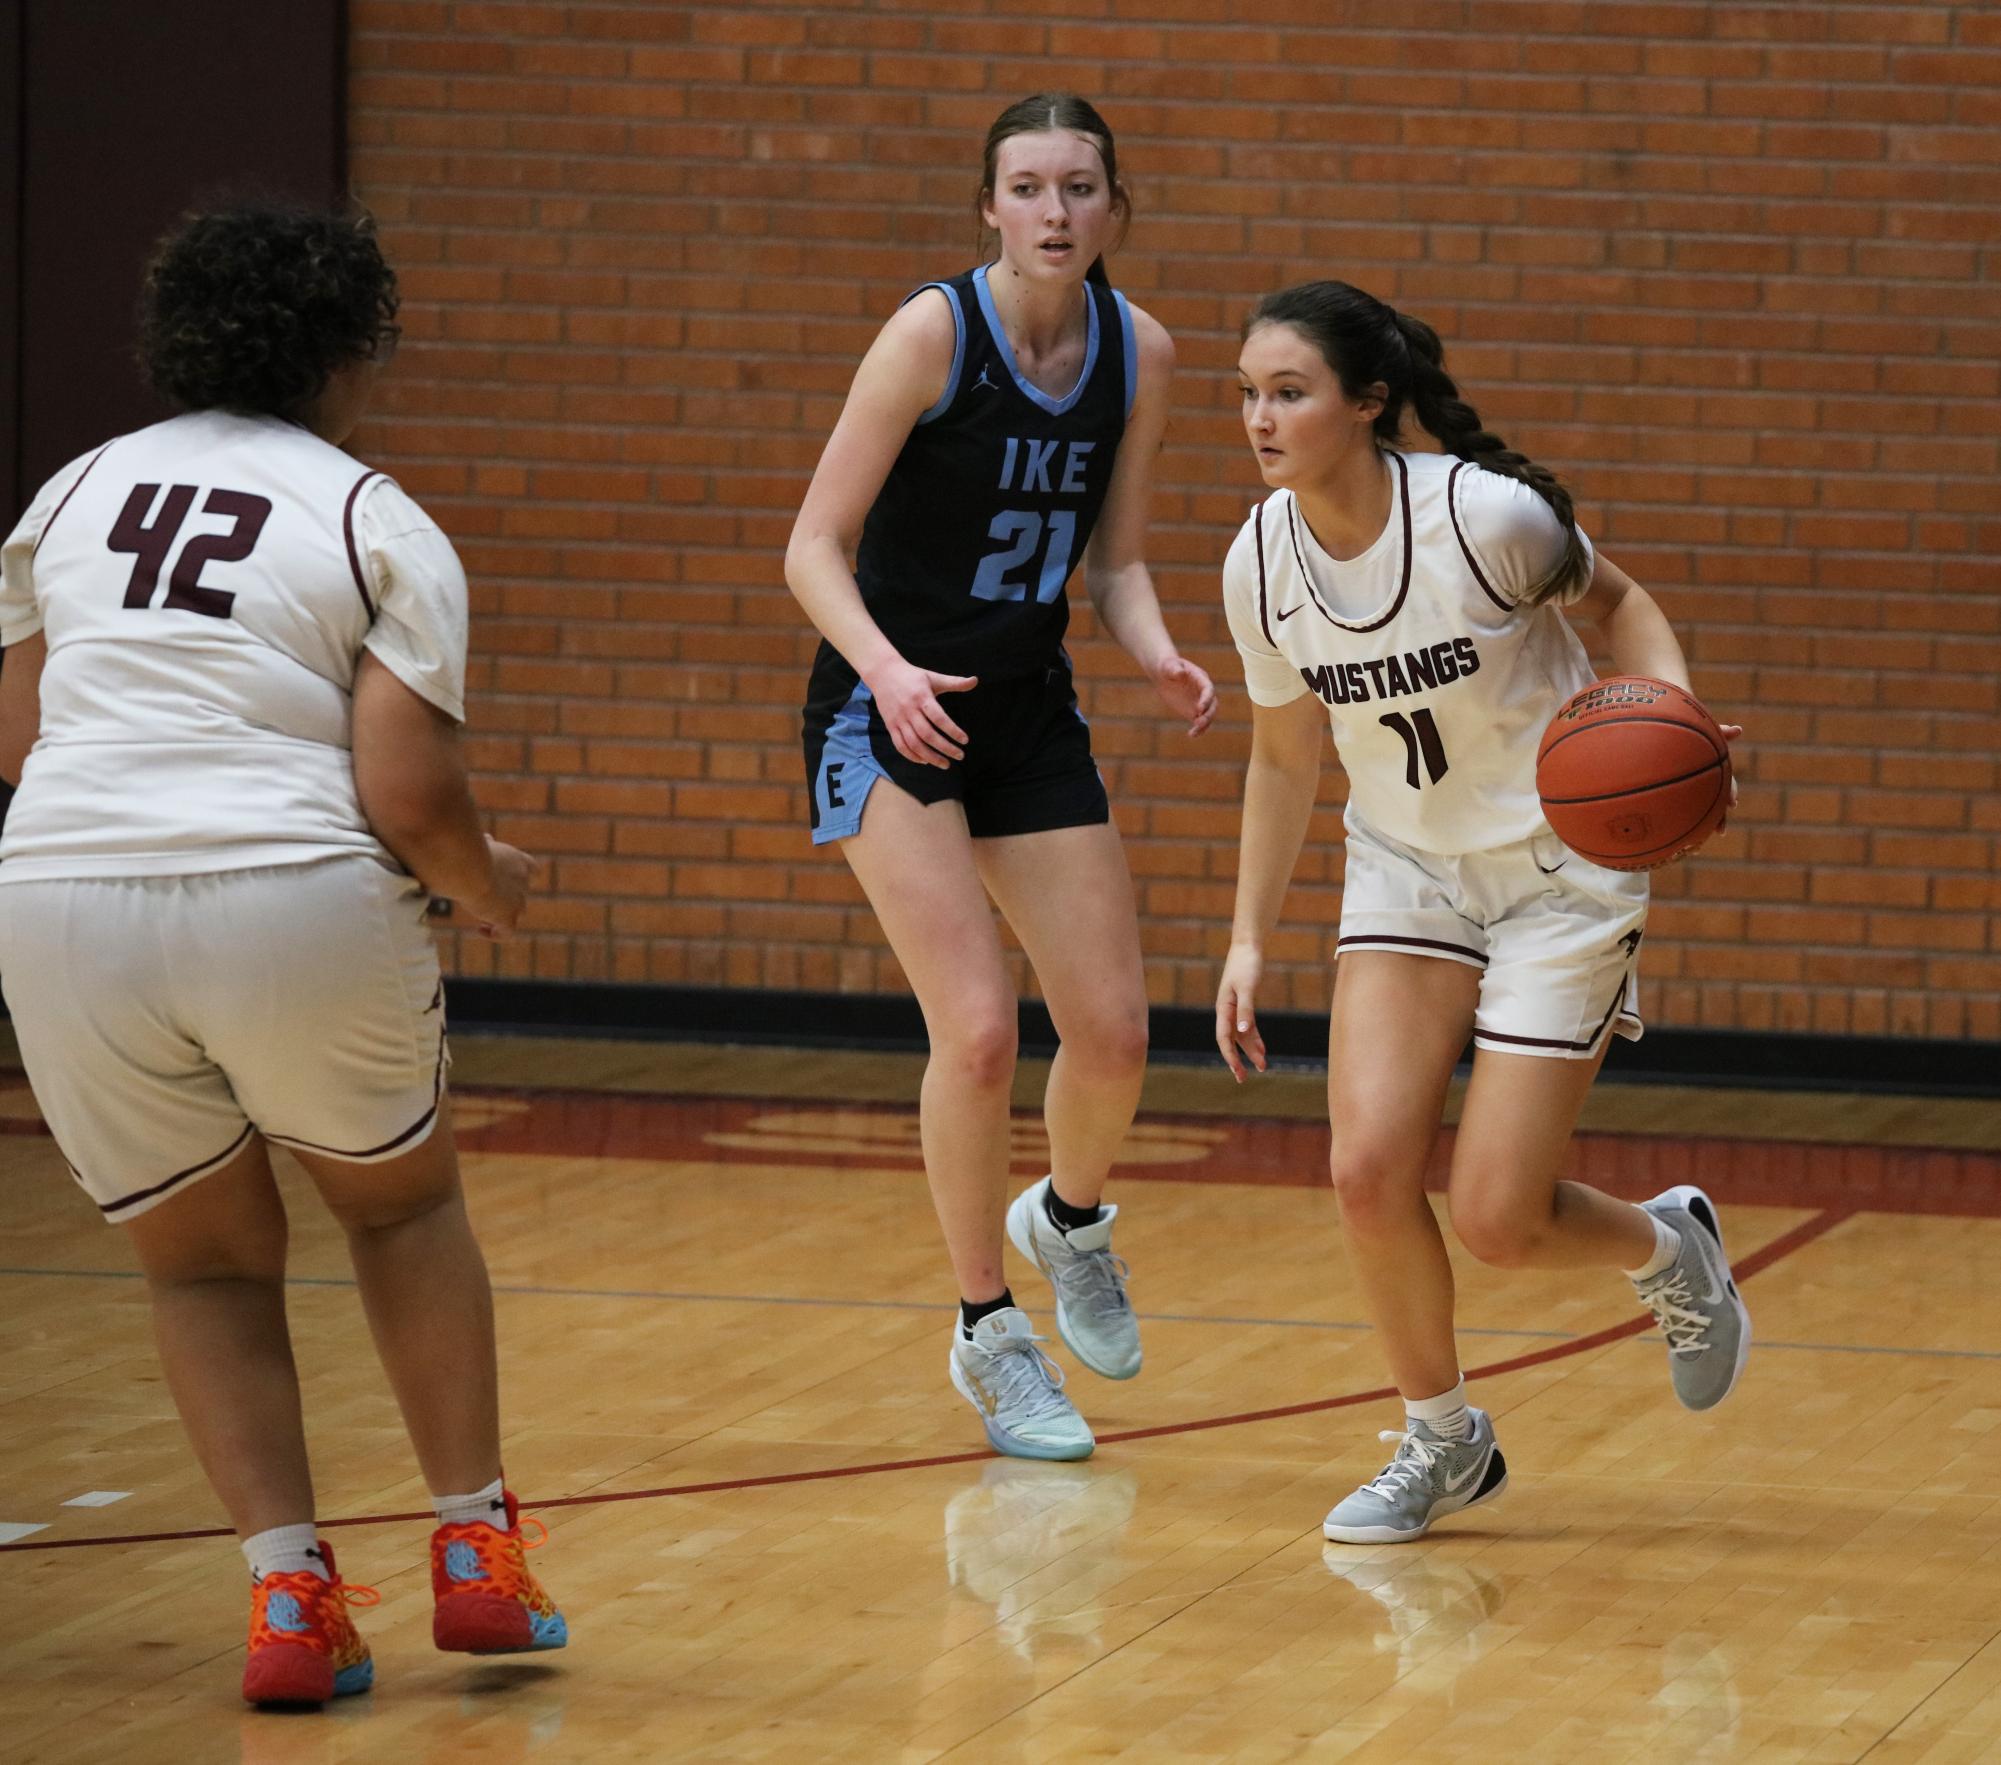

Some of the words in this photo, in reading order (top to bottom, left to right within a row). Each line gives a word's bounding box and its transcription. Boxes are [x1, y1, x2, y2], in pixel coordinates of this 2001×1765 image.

[998, 437, 1097, 493] IKE
[106, 483, 272, 619] 42
[970, 509, 1077, 604] 21
[1300, 637, 1480, 704] MUSTANGS
[1557, 684, 1667, 720] LEGACY
[1378, 708, 1448, 790] 11
[826, 762, 846, 809] E
